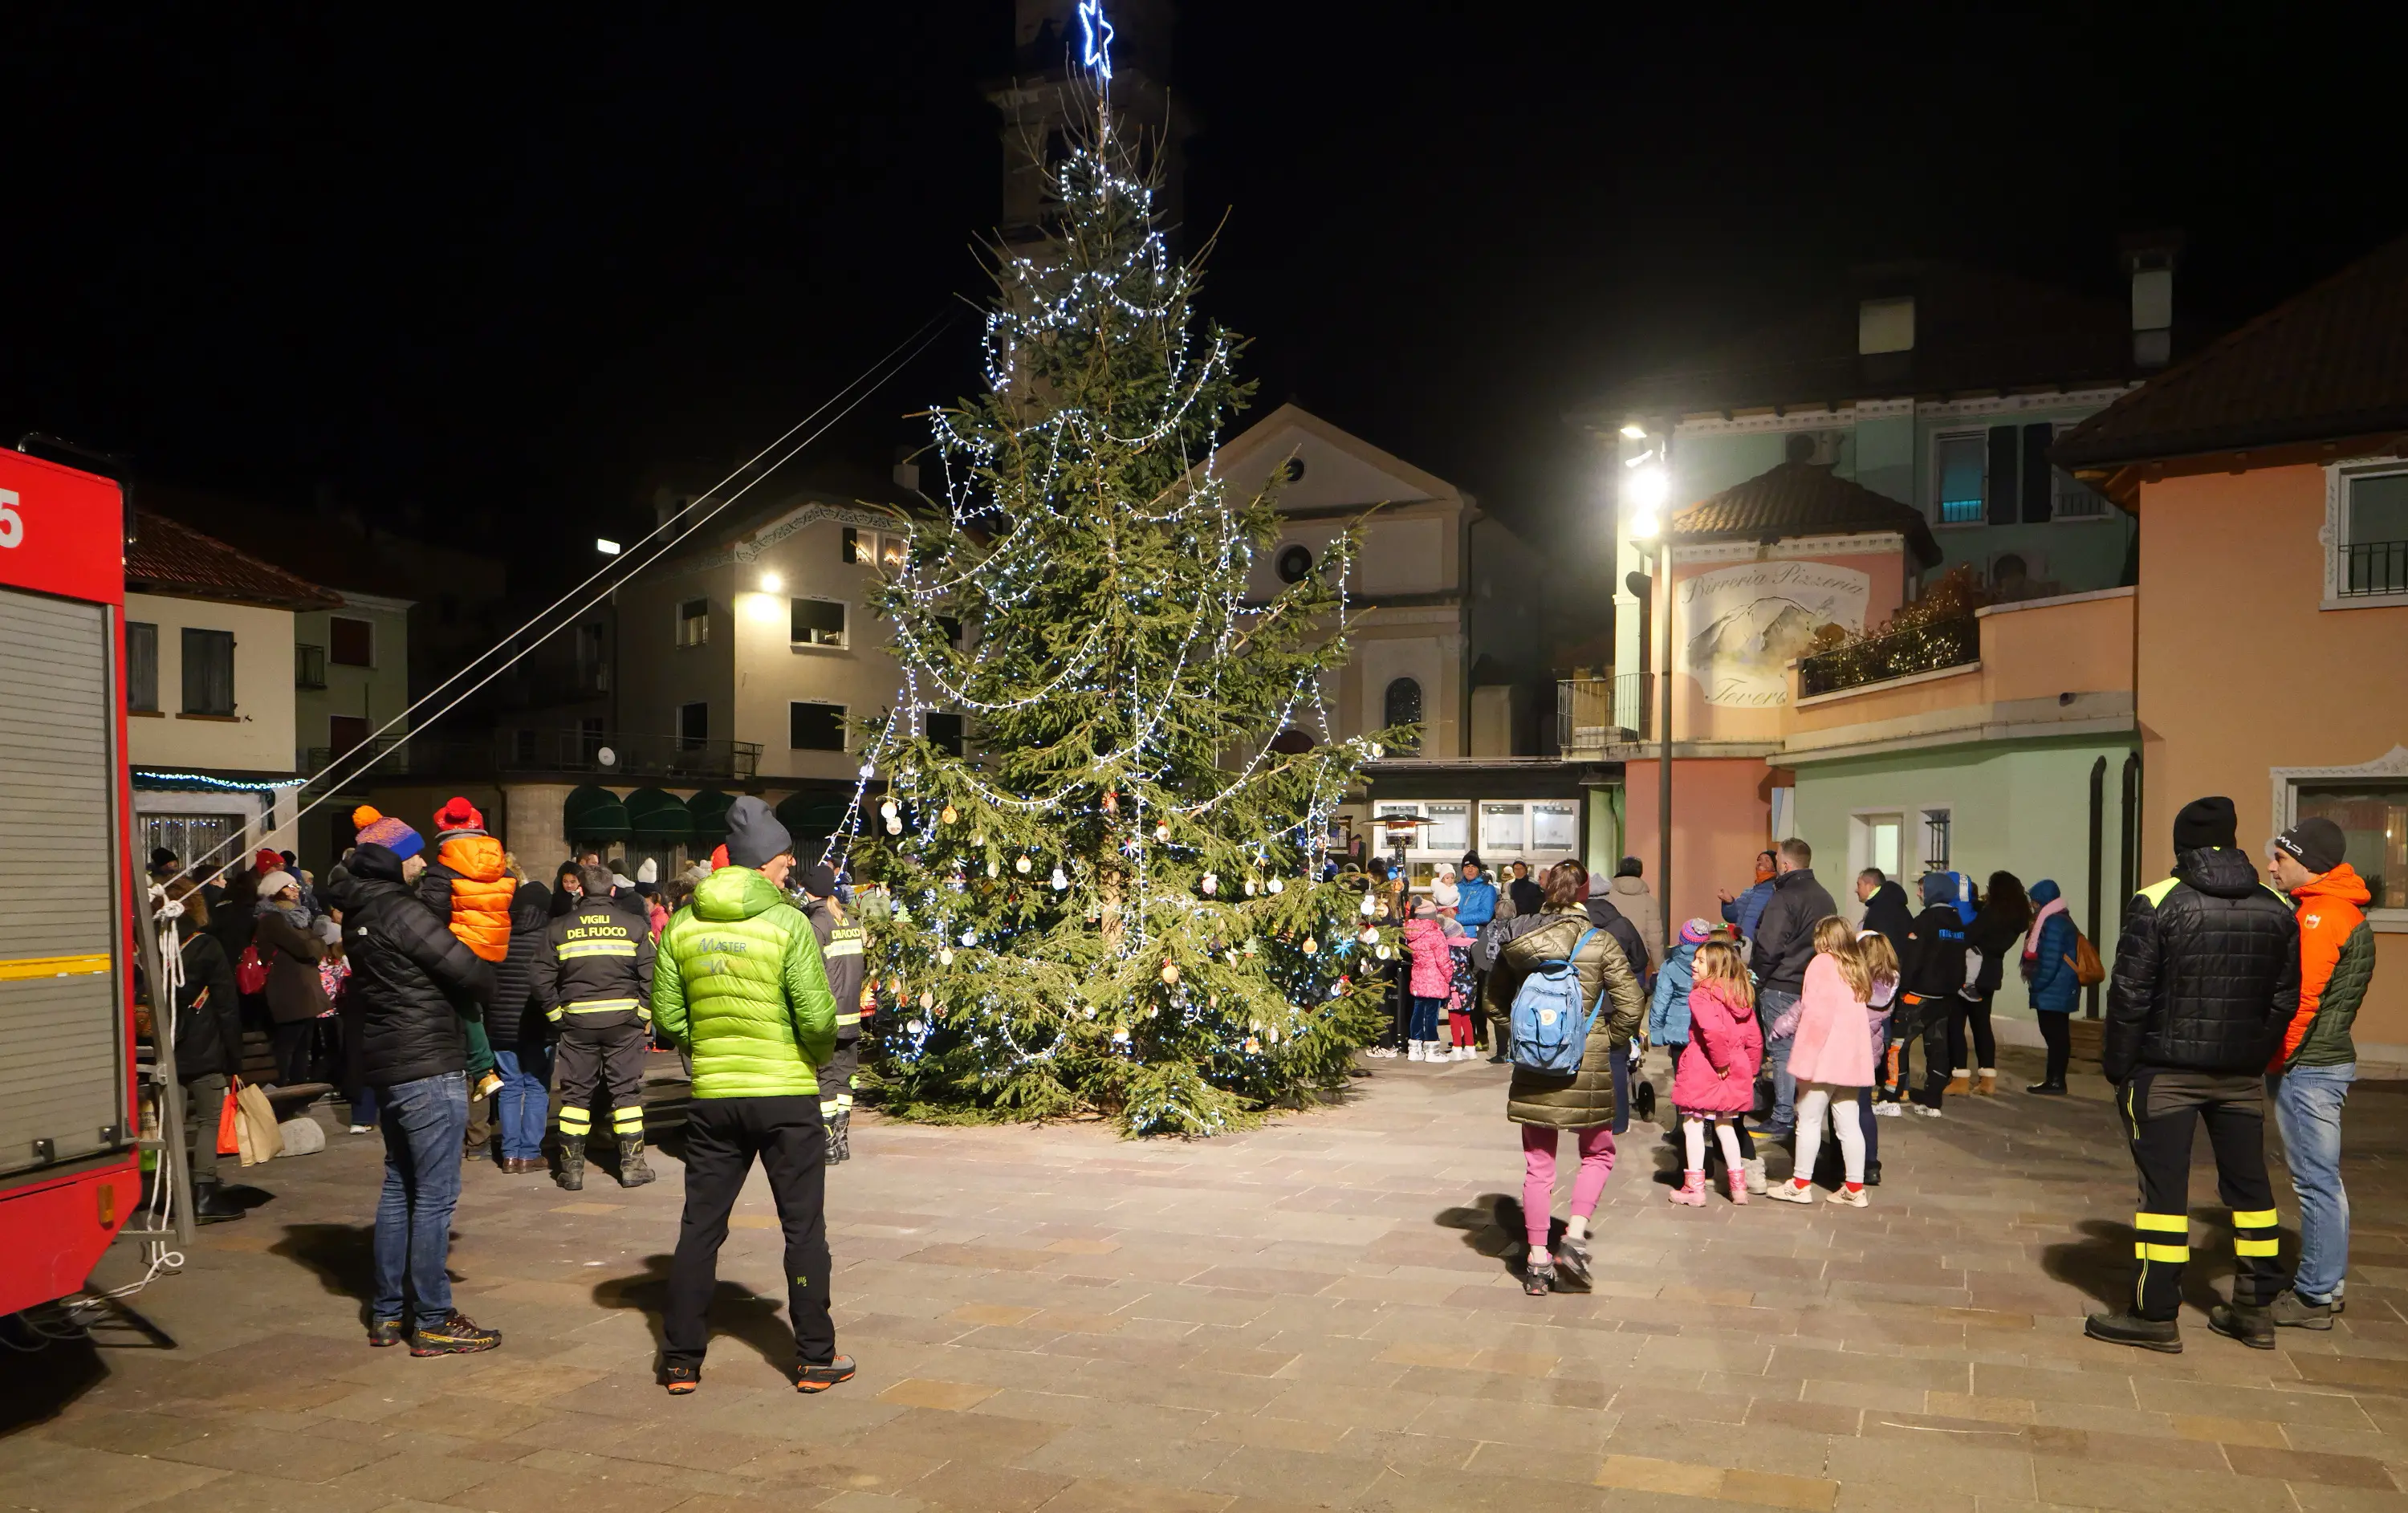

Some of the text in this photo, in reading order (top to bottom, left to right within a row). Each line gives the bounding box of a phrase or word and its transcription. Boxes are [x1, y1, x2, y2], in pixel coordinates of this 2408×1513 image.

[0, 487, 23, 548] 5
[1682, 563, 1865, 604] Birreria Pizzeria
[580, 915, 610, 925] VIGILI
[567, 926, 627, 940] DEL FUOCO
[697, 937, 746, 953] MASTER
